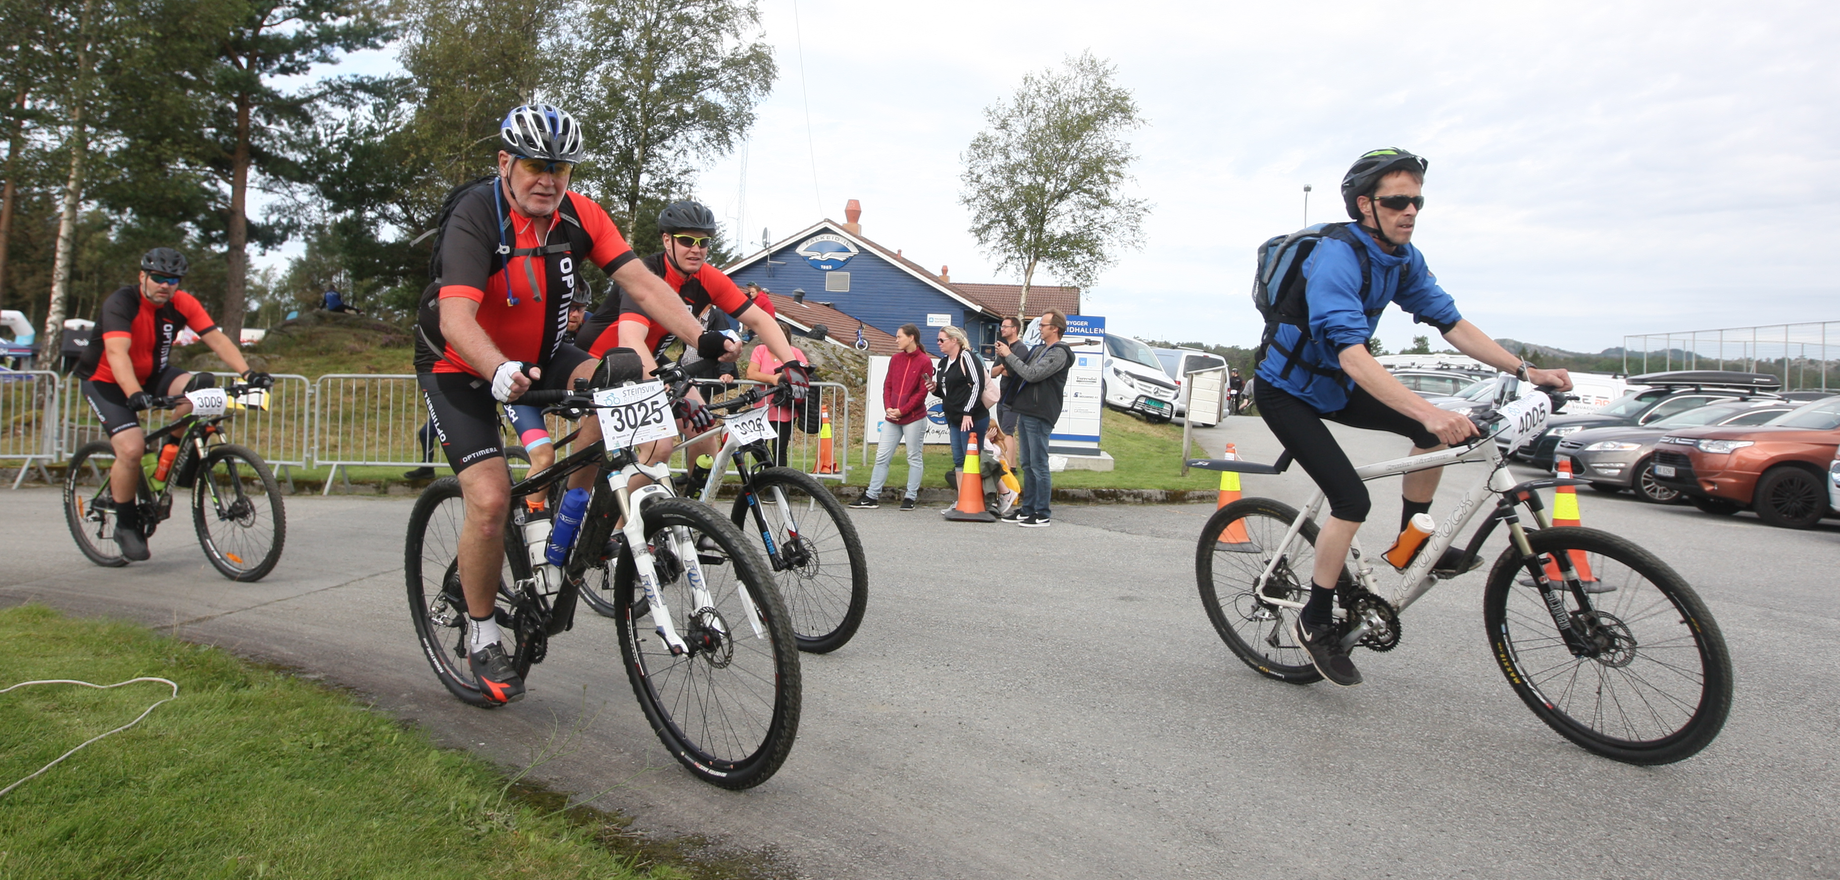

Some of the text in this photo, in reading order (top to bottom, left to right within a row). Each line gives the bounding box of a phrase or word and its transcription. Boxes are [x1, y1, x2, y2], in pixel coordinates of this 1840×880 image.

[1064, 326, 1104, 334] IDHALLEN
[197, 396, 223, 408] 3009
[610, 400, 664, 432] 3025
[1518, 402, 1546, 436] 4005
[462, 447, 498, 463] OPTIMERA
